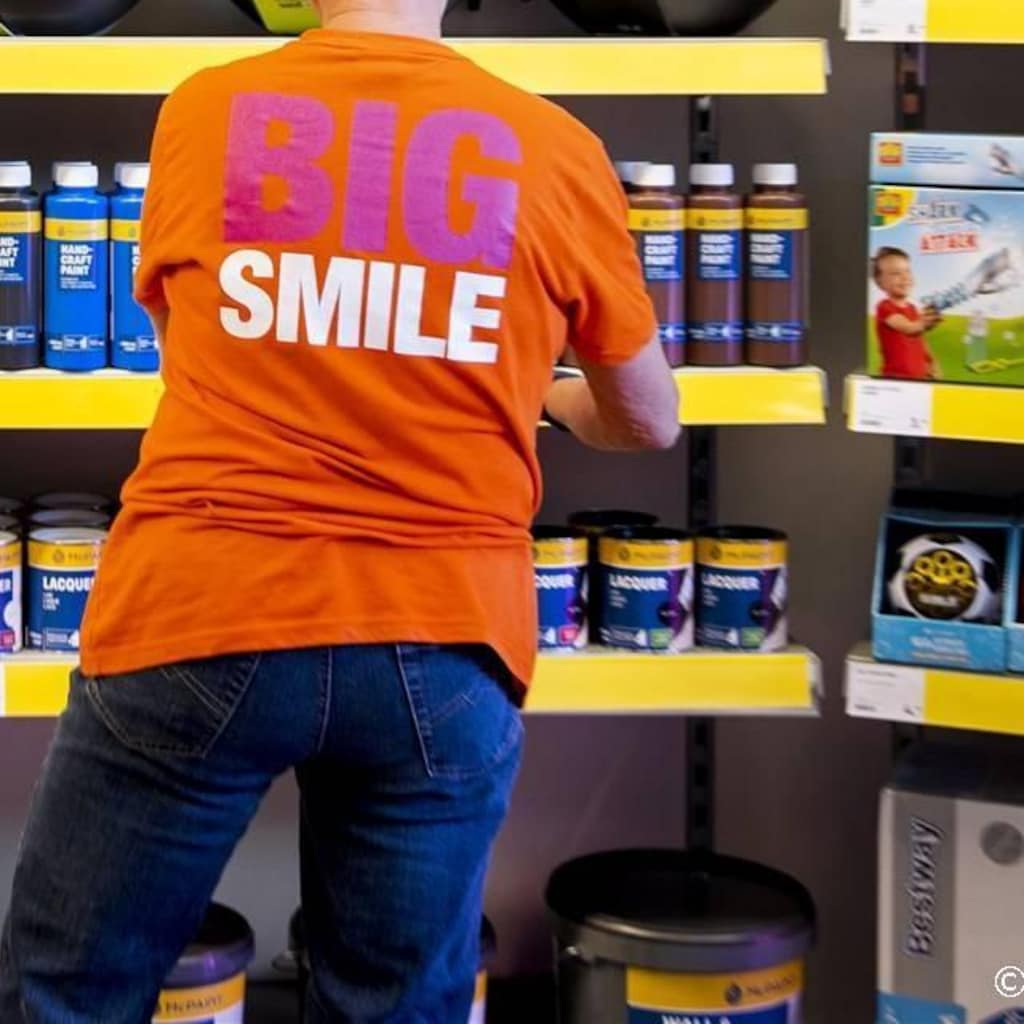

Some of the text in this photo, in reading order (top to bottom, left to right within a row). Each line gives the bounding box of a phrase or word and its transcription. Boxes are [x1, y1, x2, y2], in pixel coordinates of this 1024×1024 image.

[223, 92, 524, 270] BIG
[60, 255, 93, 265] CRAFT
[60, 265, 90, 275] PAINT
[219, 249, 507, 364] SMILE
